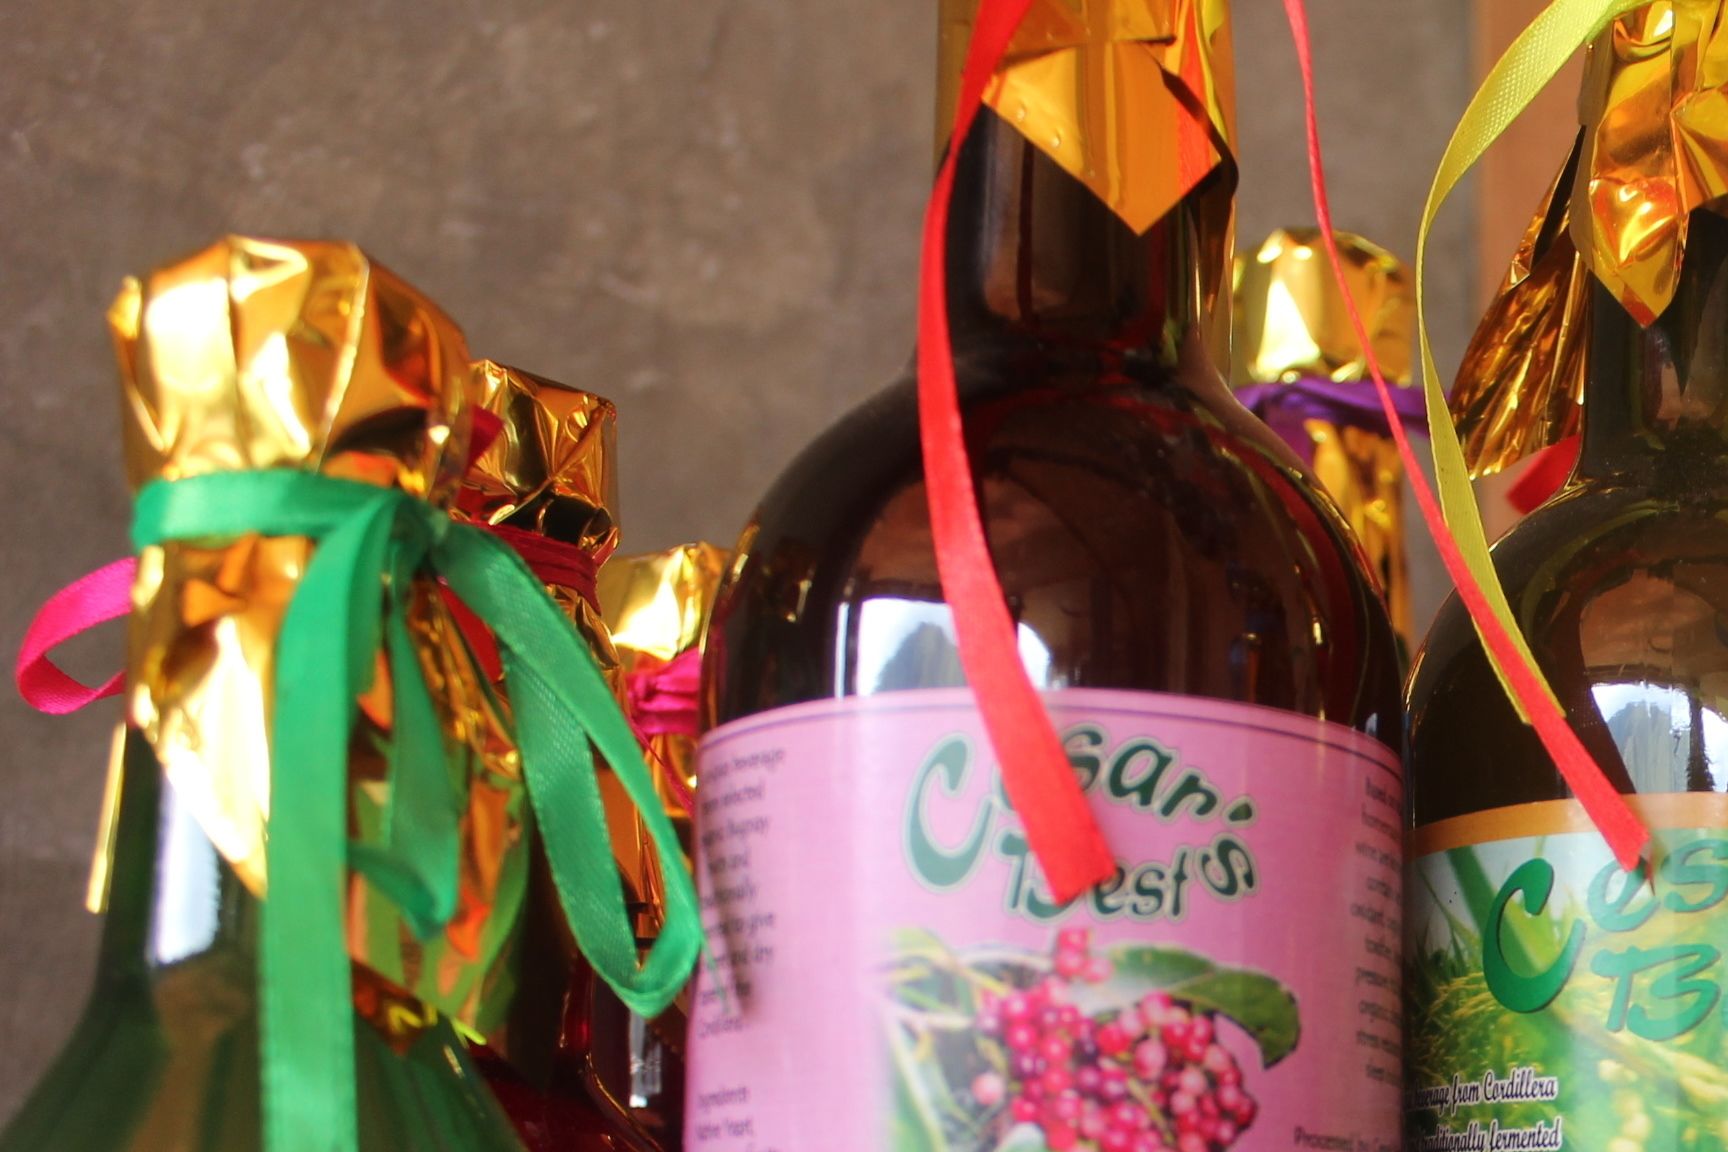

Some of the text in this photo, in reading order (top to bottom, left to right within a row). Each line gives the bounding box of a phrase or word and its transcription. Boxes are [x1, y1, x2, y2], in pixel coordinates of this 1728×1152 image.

[903, 723, 1258, 896] Csar's
[1451, 1074, 1480, 1117] from
[1483, 1066, 1558, 1102] Cordillera
